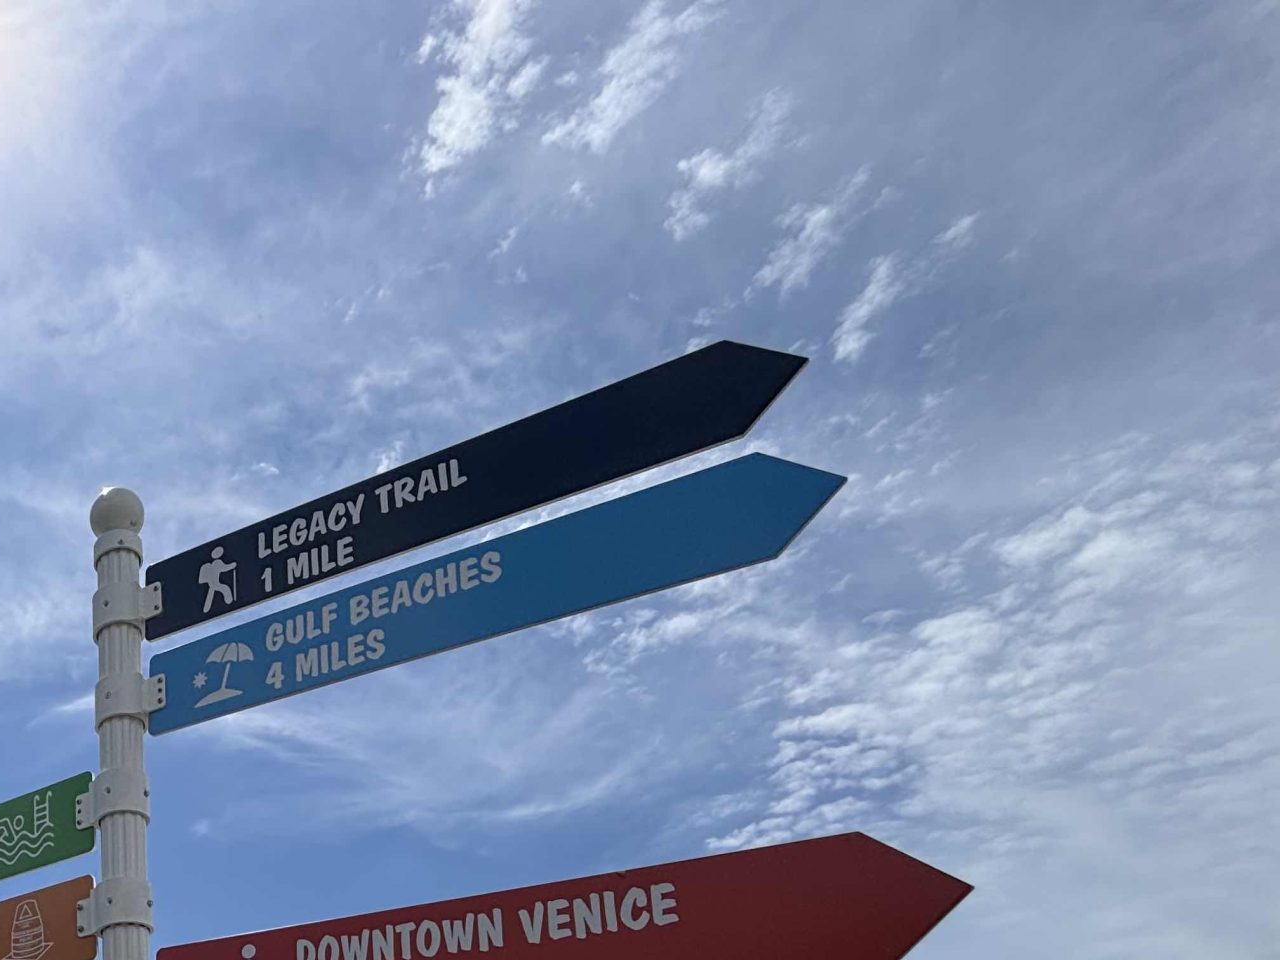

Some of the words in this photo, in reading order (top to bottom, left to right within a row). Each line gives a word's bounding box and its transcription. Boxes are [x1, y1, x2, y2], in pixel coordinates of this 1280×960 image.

[258, 493, 365, 558] LEGACY
[375, 459, 468, 514] TRAIL
[261, 567, 273, 593] 1
[287, 536, 355, 584] MILE
[265, 603, 339, 652] GULF
[349, 551, 502, 626] BEACHES
[265, 662, 285, 689] 4
[296, 629, 386, 682] MILES
[519, 883, 680, 944] VENICE
